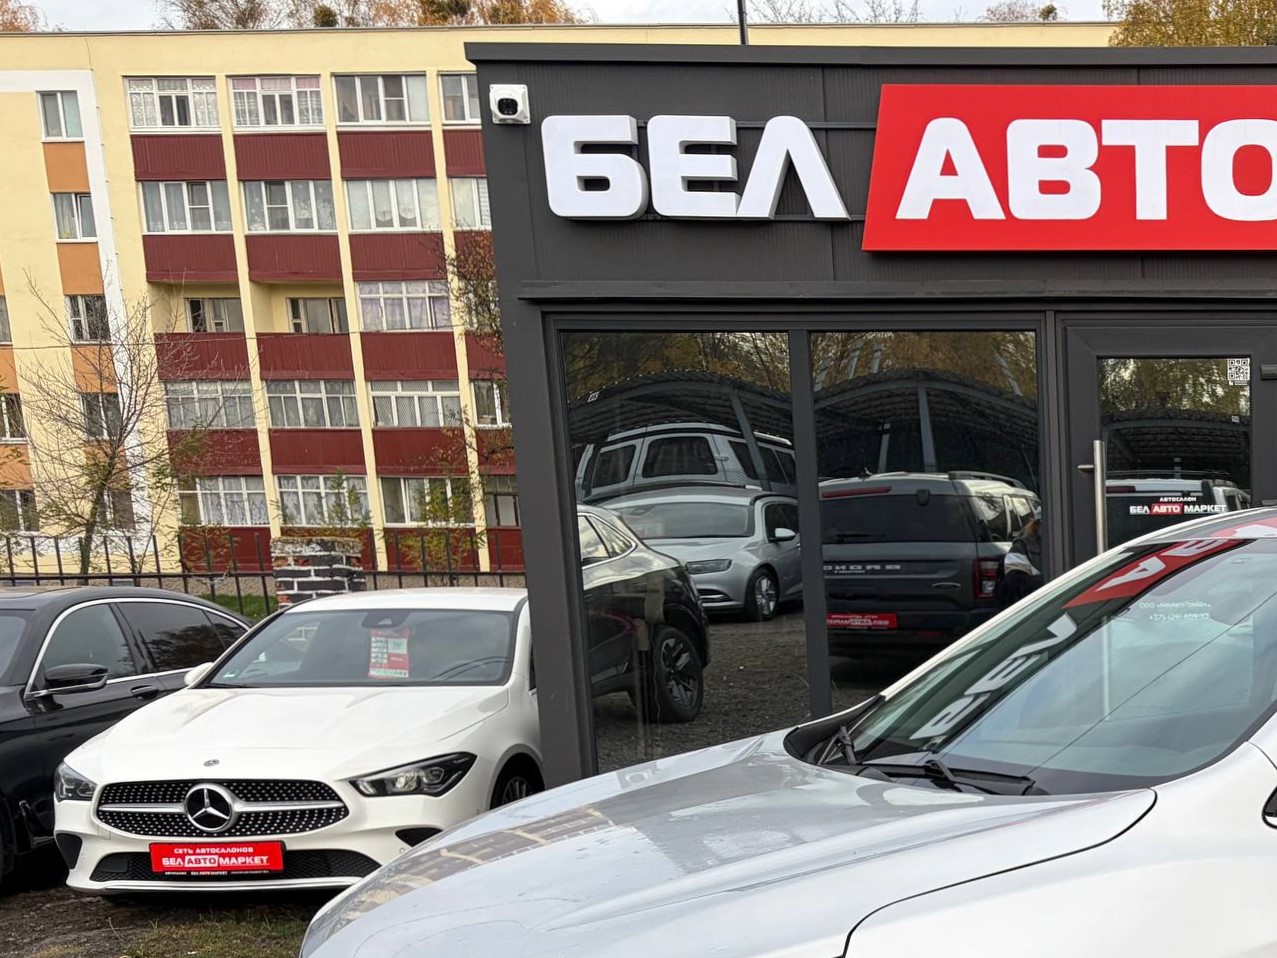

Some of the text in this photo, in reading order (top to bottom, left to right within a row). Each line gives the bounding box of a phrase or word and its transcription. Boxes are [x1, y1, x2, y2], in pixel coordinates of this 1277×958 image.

[541, 115, 850, 221] БЕЛ
[1129, 504, 1228, 515] БЕЛ АВТО МАРКЕТ
[162, 856, 268, 866] БЕЛ АВТО МАРКЕТ
